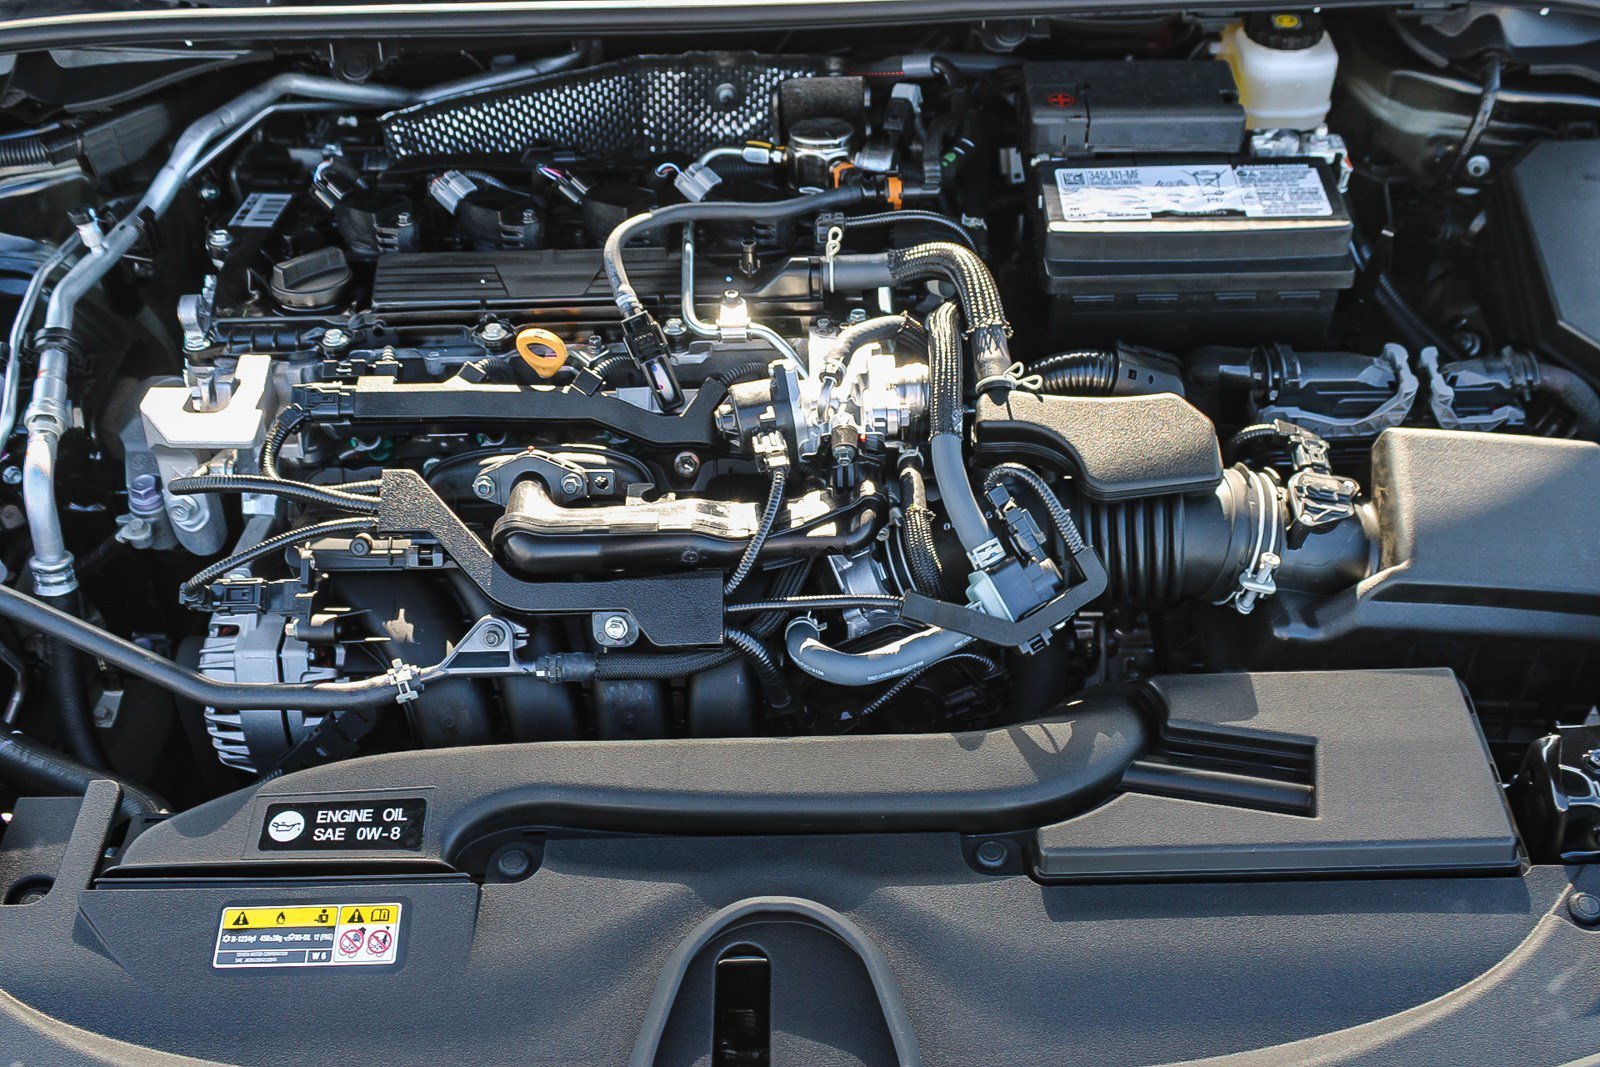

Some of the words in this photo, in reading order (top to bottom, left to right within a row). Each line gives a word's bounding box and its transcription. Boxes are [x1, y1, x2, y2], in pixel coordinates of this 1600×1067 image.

[316, 808, 373, 824] ENGINE
[382, 807, 408, 822] OIL
[312, 827, 346, 841] SAE
[356, 826, 401, 840] 0W-8
[312, 951, 320, 960] W
